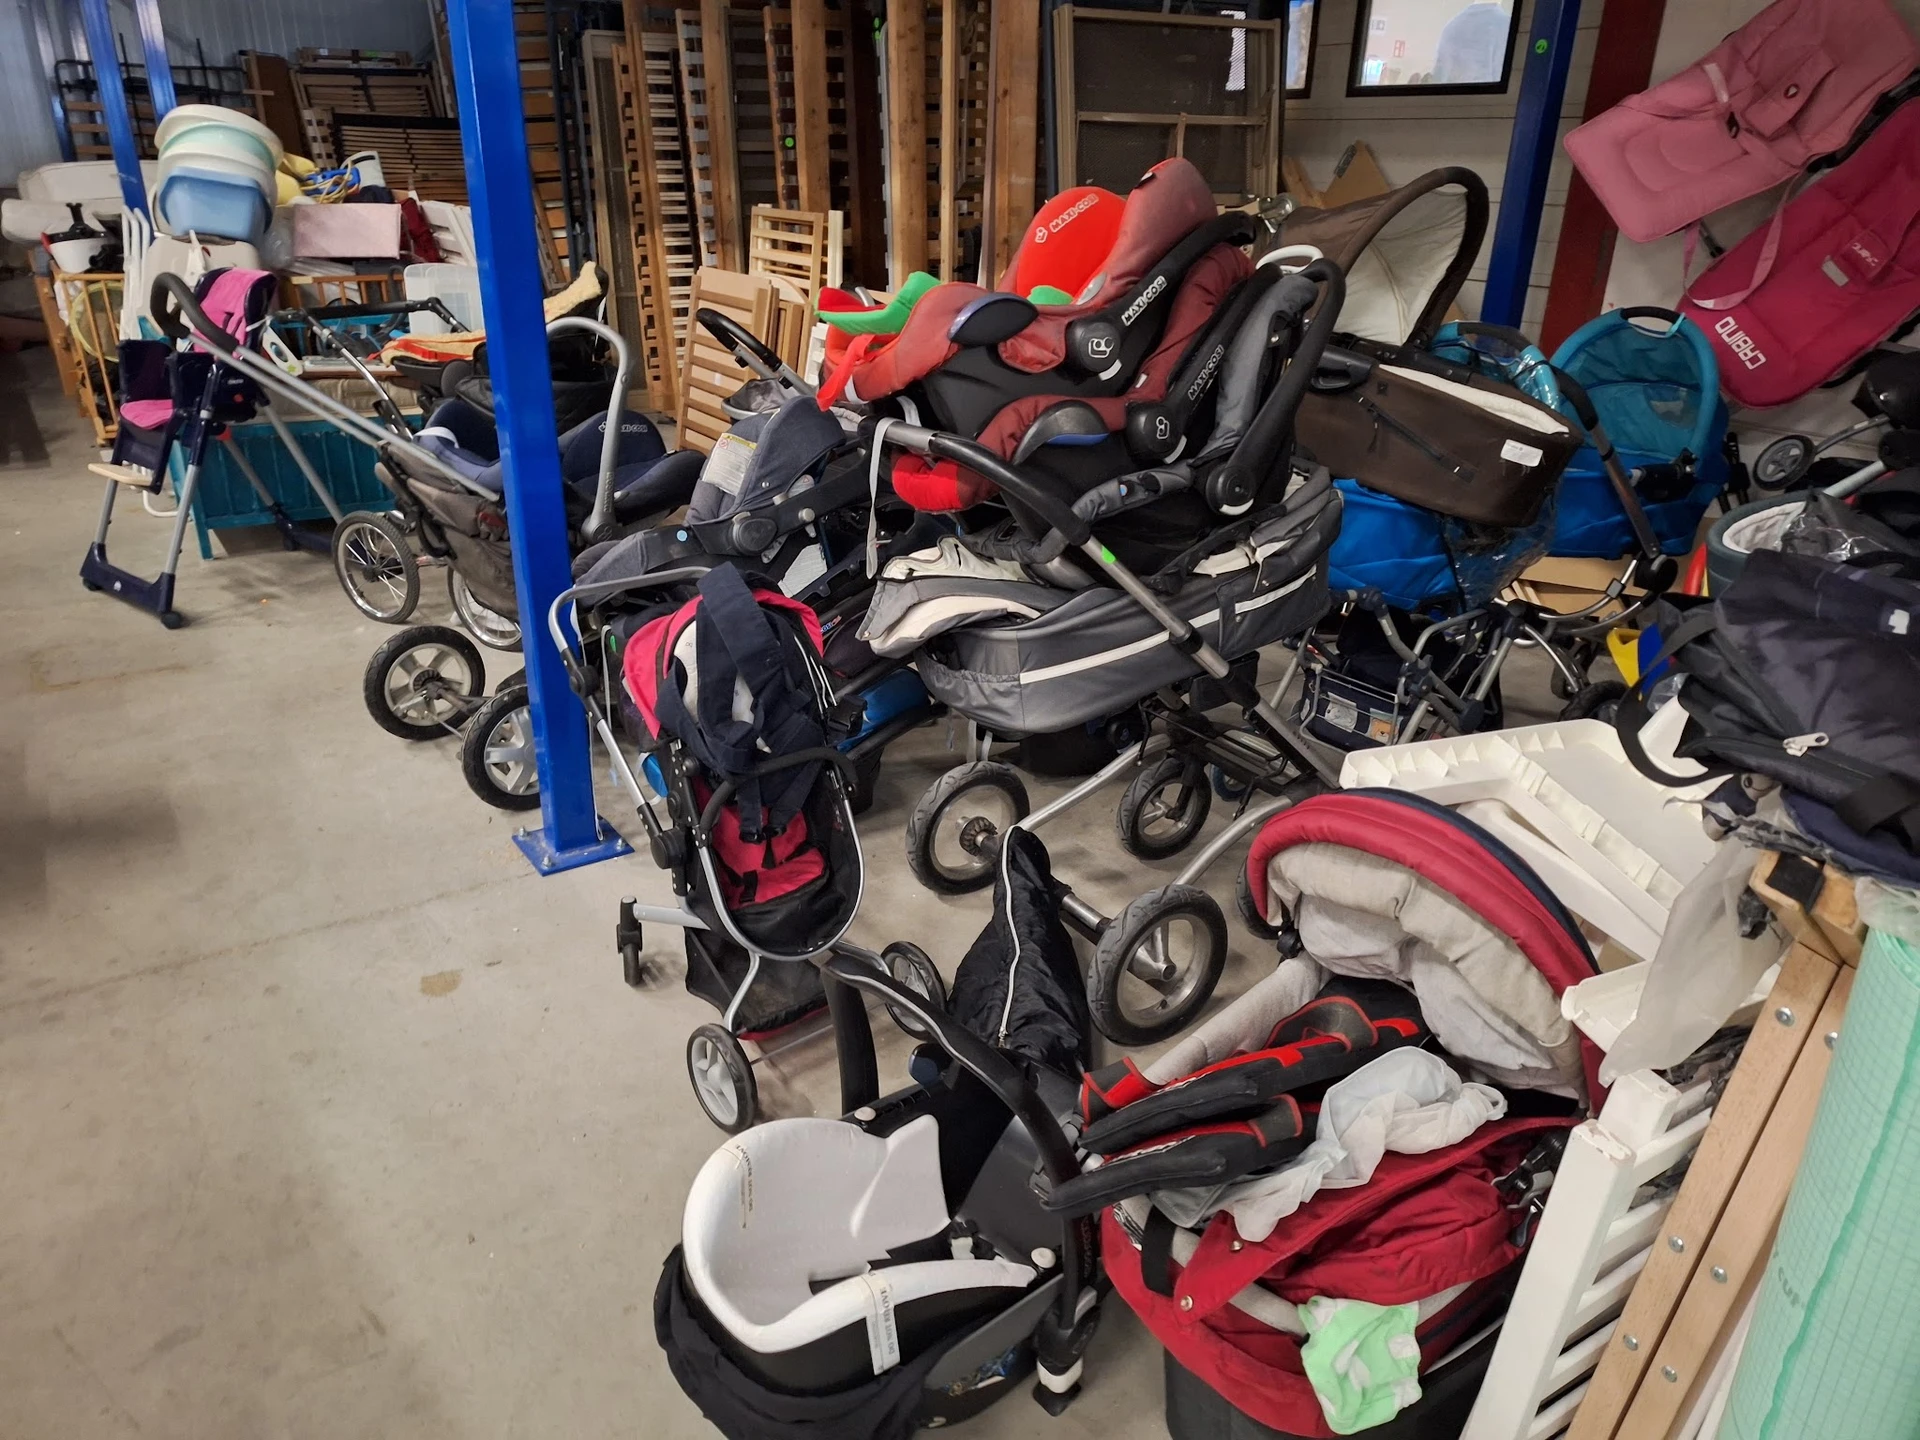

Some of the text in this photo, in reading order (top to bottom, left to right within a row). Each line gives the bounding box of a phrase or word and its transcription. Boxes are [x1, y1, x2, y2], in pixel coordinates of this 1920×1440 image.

[1049, 193, 1100, 233] MAXI-COSI
[1121, 276, 1168, 327] MAXI-COSI
[1714, 316, 1767, 370] CABINO
[1188, 344, 1225, 401] MAXI-COSI
